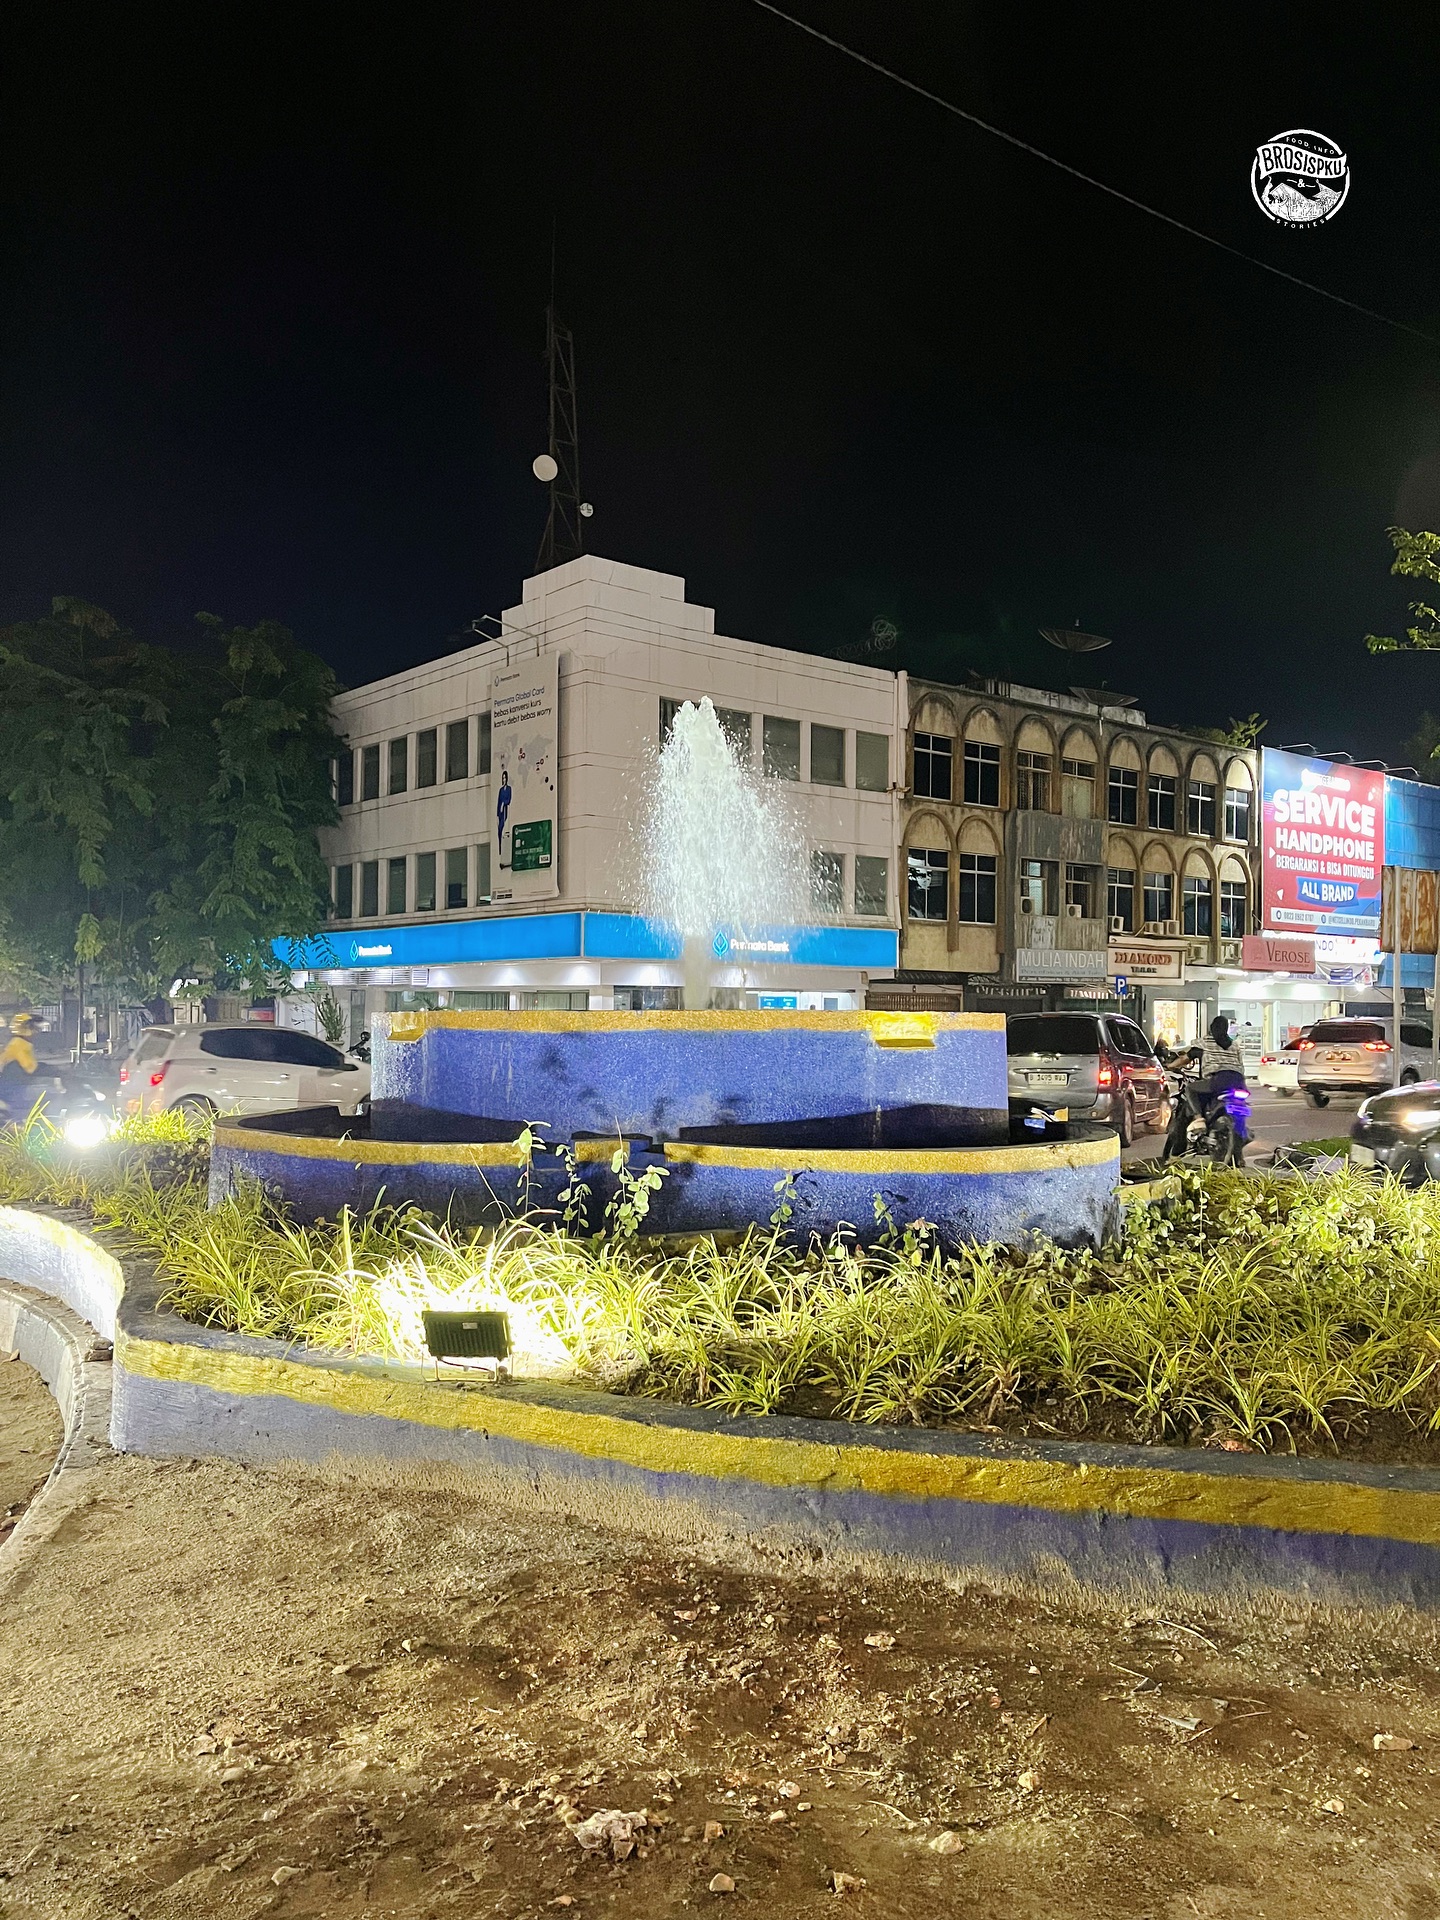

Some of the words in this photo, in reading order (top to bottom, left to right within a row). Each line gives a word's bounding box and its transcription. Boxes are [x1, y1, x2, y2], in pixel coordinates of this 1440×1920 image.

[494, 697, 515, 707] Permata
[516, 690, 531, 701] Global
[532, 685, 545, 696] Card
[494, 709, 509, 718] bebas
[510, 701, 530, 714] konversi
[531, 700, 542, 708] kurs
[507, 715, 520, 725] debit
[521, 711, 536, 721] bebas
[1273, 789, 1375, 838] SERVICE
[1276, 827, 1374, 862] HANDPHONE
[1276, 854, 1319, 873] BERGARANSI
[1320, 861, 1325, 874] &
[1327, 861, 1341, 876] BISA
[1343, 864, 1375, 880] DITUNGGU
[1301, 881, 1320, 900] ALL
[1321, 883, 1354, 902] BRAND
[1021, 950, 1062, 968] MULIA
[1065, 952, 1104, 969] INDAH
[1114, 952, 1172, 965] DIAMOND
[1266, 941, 1311, 964] VEROSE
[1117, 978, 1126, 993] P
